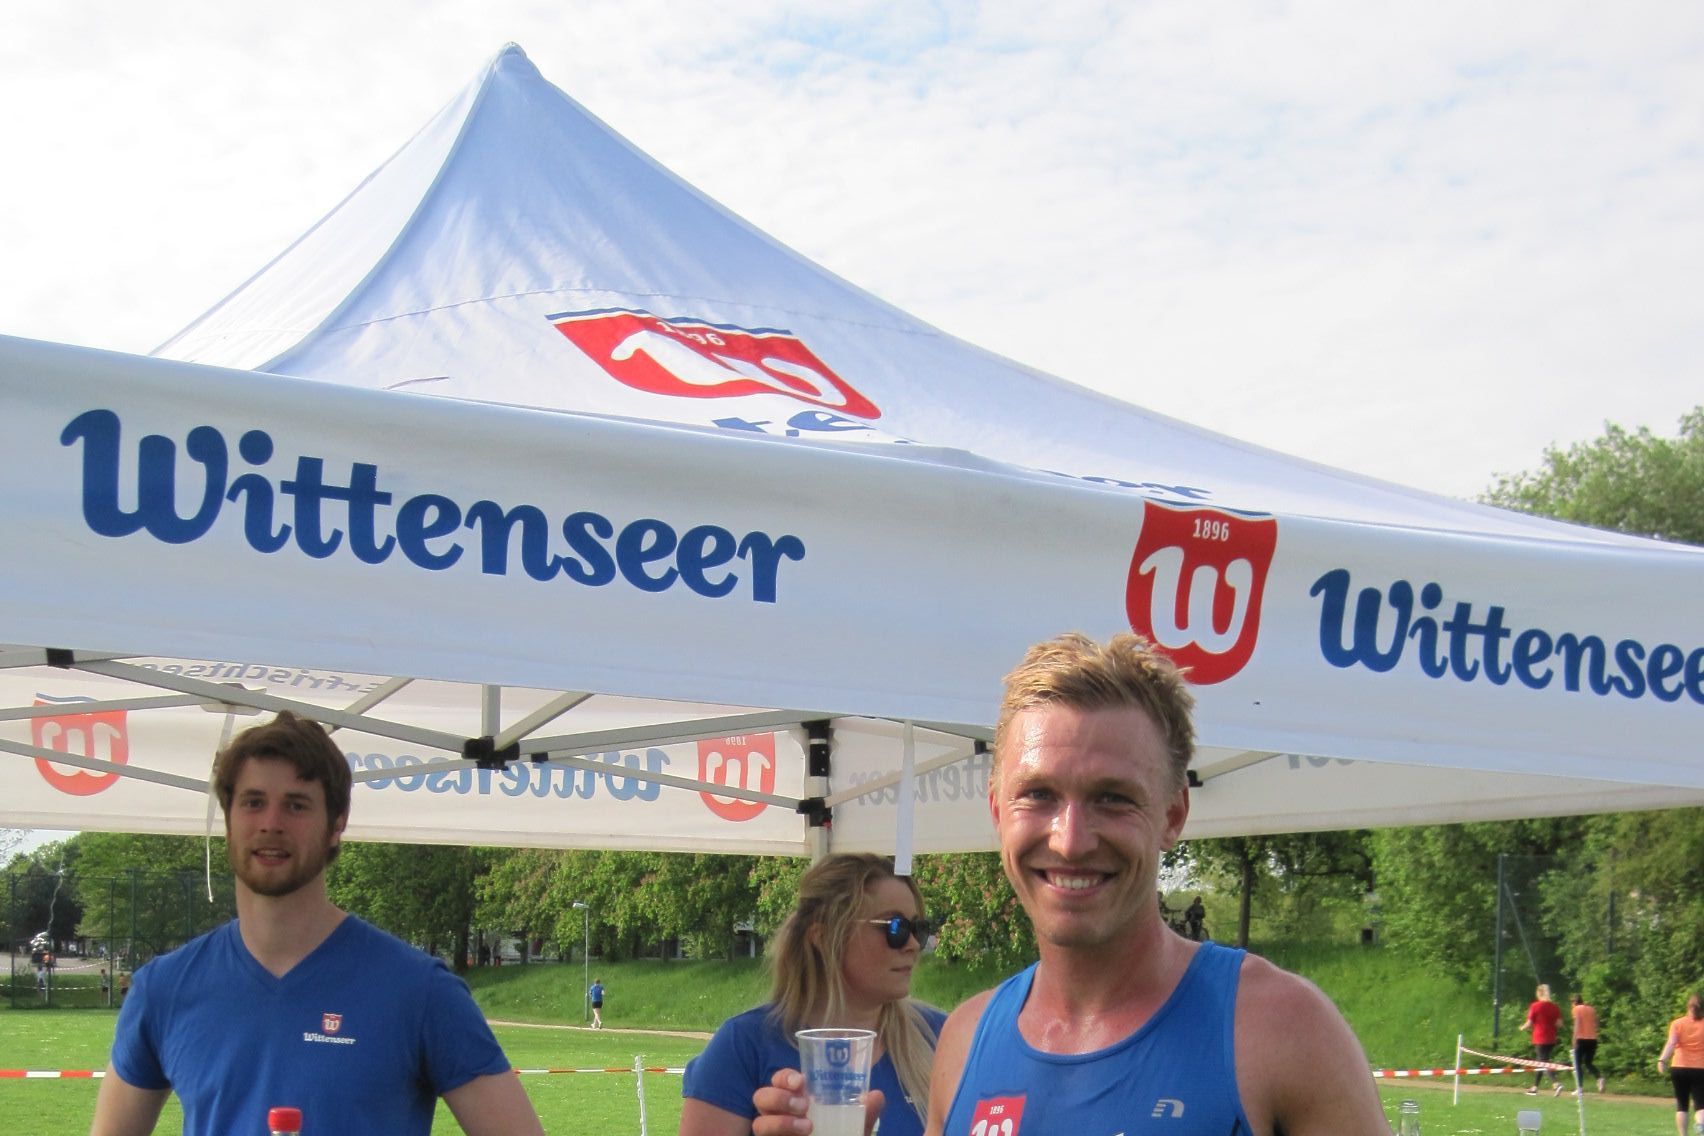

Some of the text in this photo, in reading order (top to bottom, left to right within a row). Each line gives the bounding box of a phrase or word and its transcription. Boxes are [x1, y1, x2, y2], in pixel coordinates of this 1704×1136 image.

[61, 409, 806, 603] Wittenseer
[1192, 518, 1230, 542] 1896
[1139, 545, 1254, 655] W
